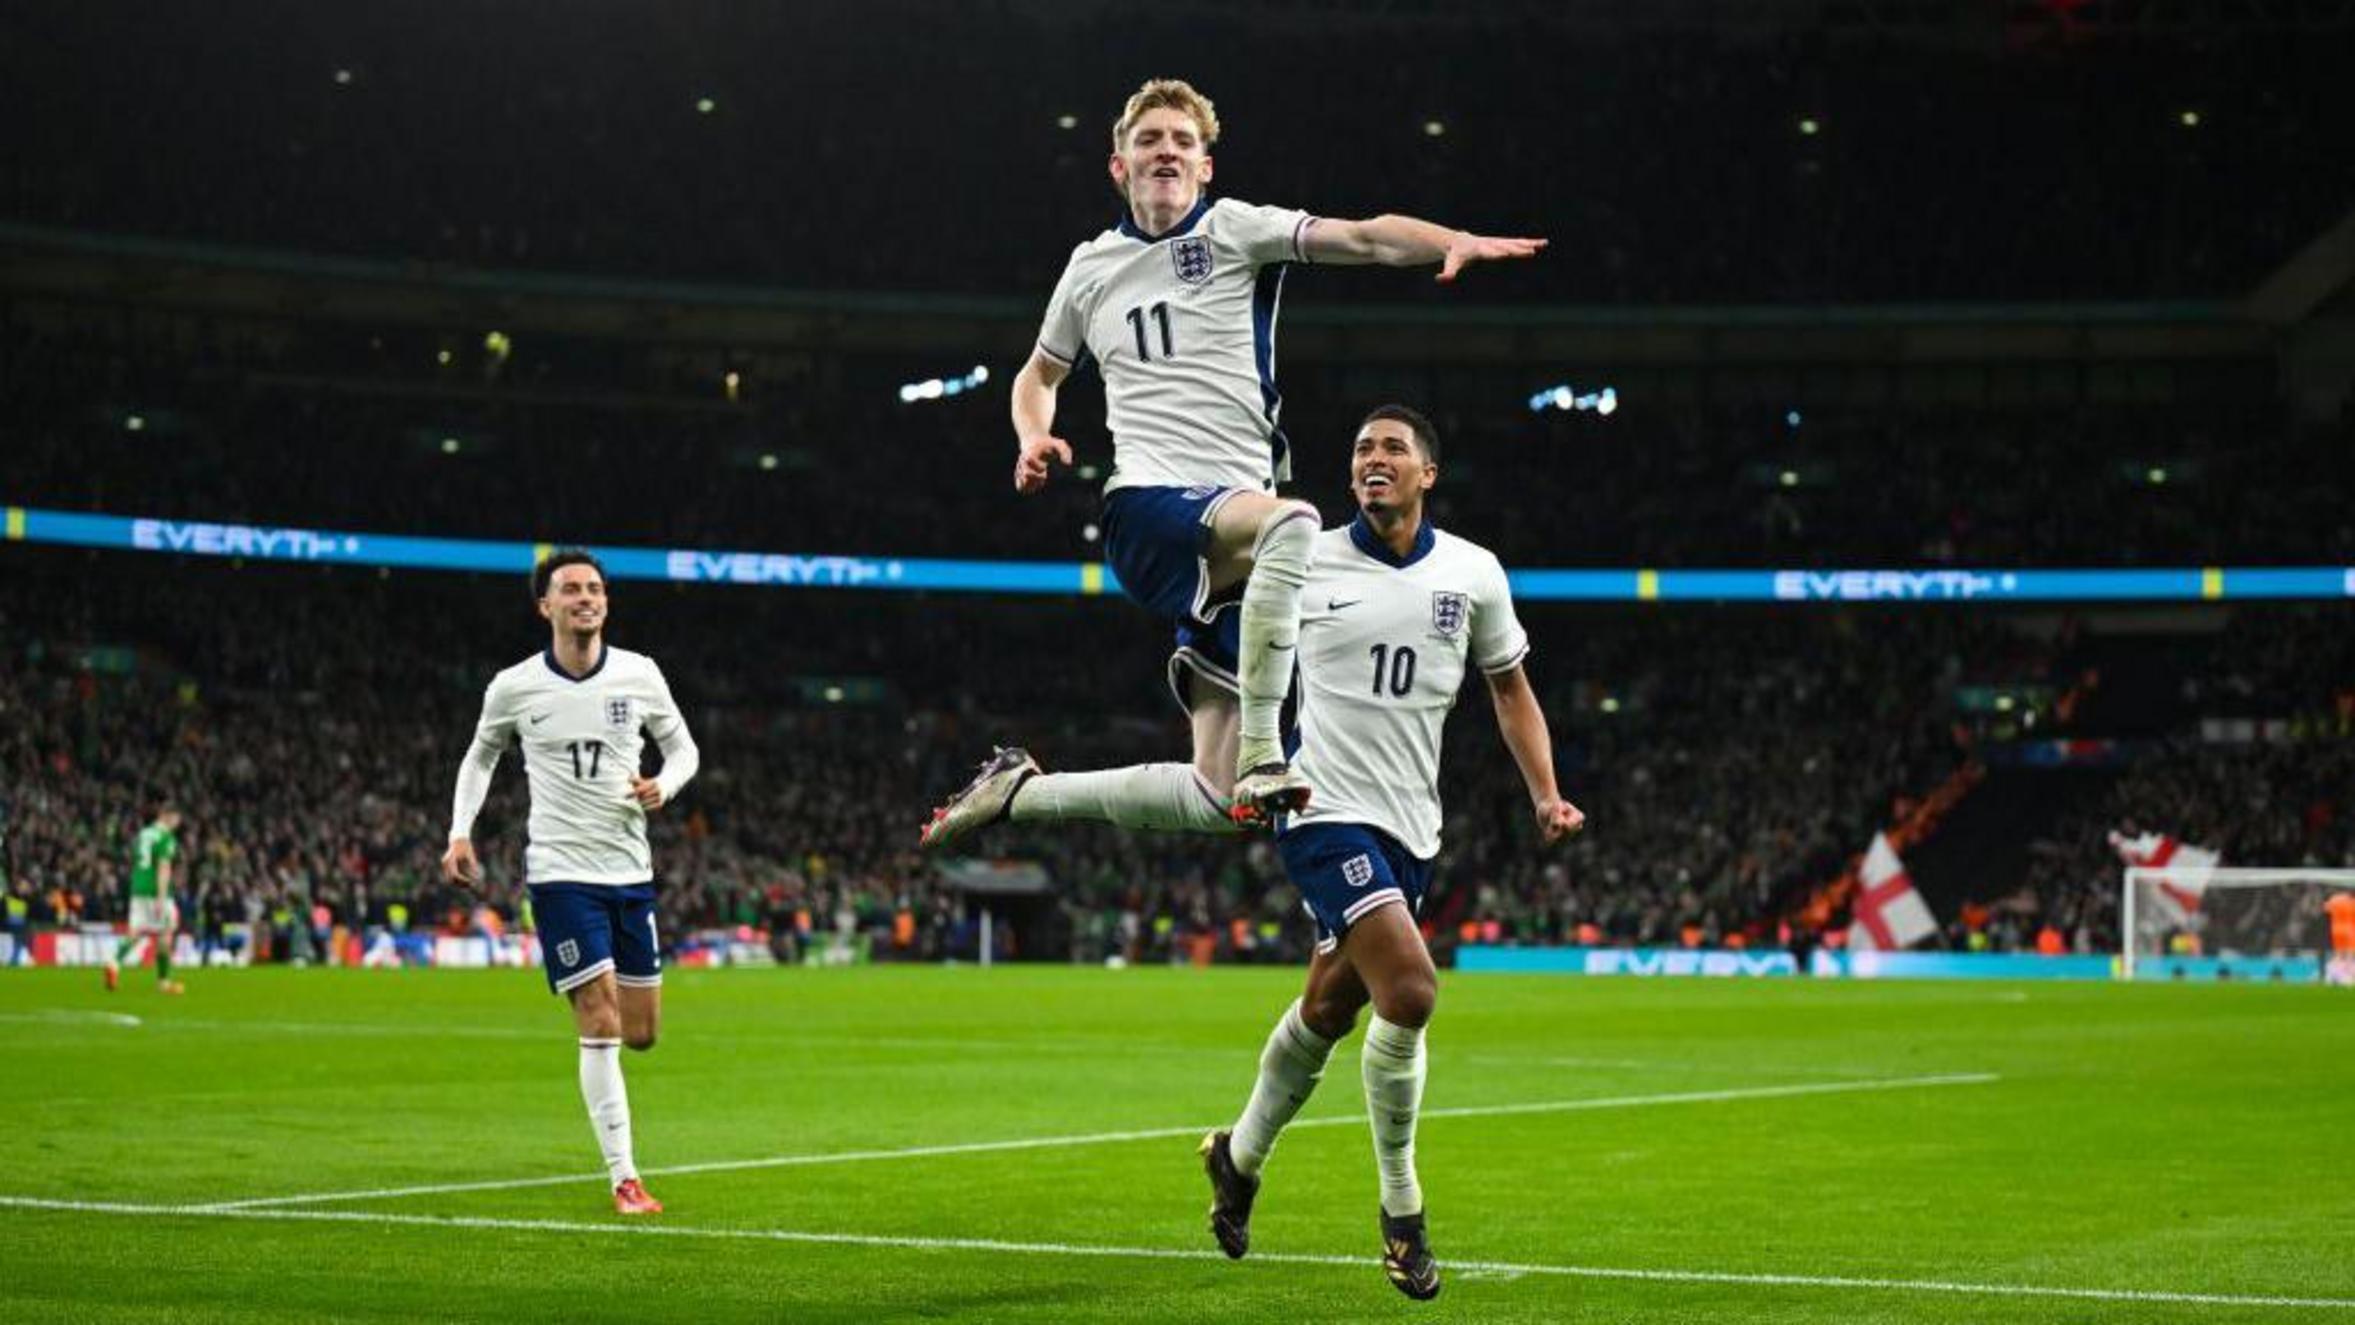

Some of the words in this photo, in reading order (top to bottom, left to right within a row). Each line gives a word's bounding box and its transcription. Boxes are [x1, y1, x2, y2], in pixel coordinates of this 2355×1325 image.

[1126, 301, 1174, 363] 11
[1370, 643, 1417, 697] 10
[566, 740, 605, 778] 17
